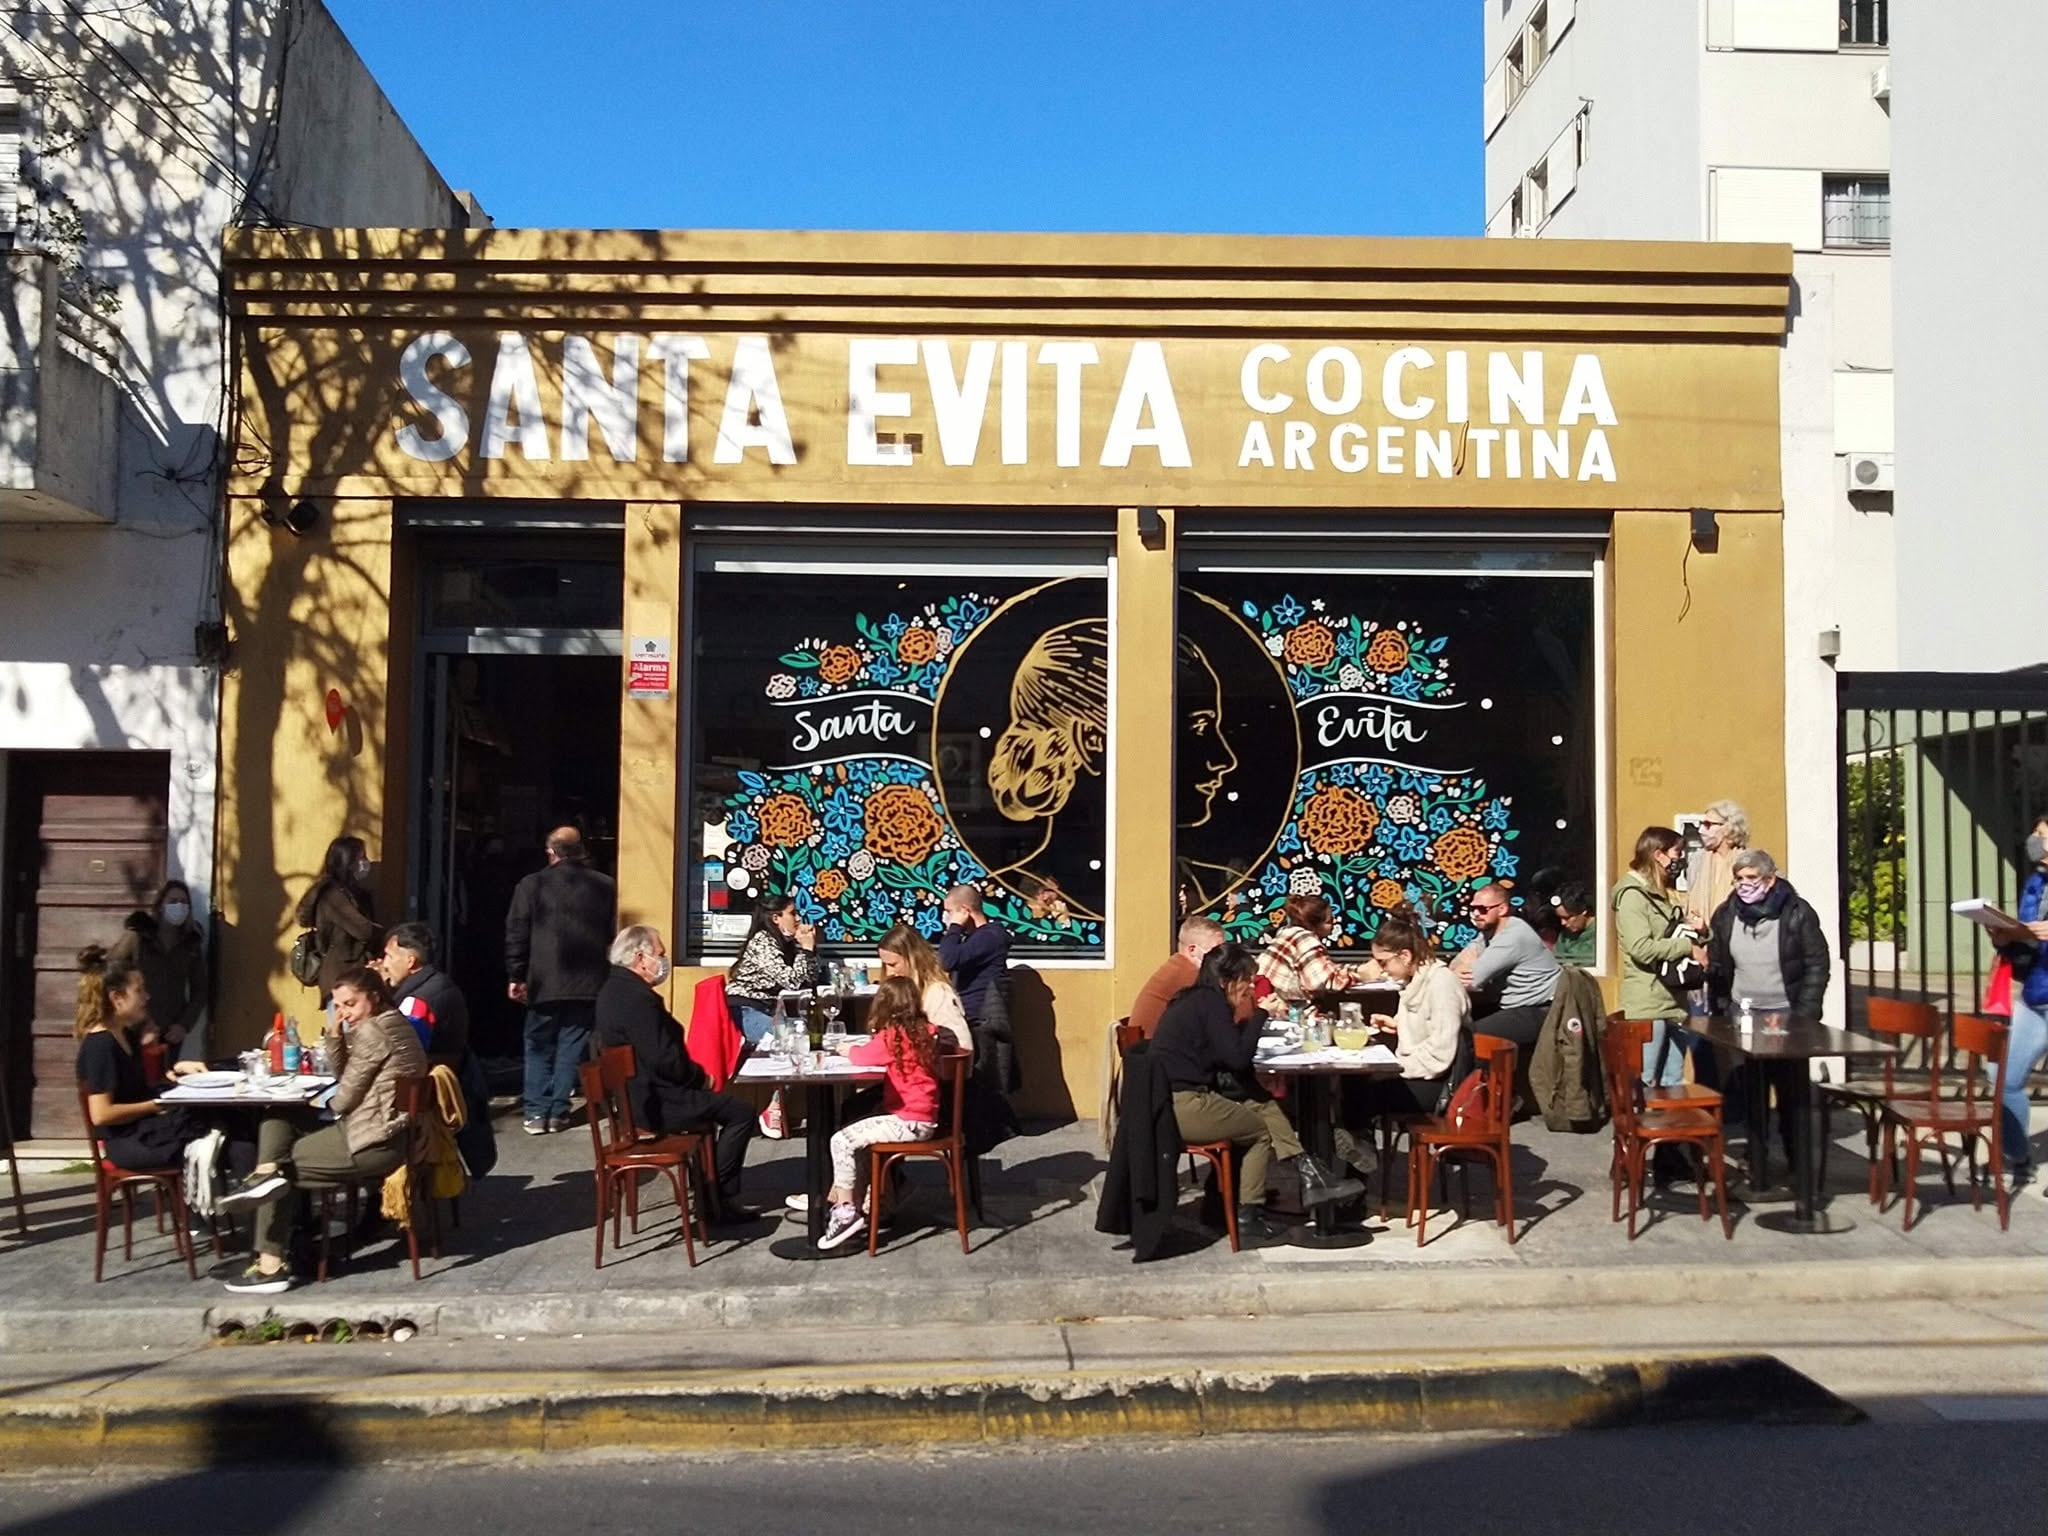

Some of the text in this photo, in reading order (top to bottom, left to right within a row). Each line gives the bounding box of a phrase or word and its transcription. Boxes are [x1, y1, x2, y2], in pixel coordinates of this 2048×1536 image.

[395, 330, 1193, 468] SANTA EVITA
[1240, 343, 1619, 426] COCINA
[1237, 421, 1618, 482] ARGENTINA
[633, 662, 667, 672] Alarma
[792, 699, 916, 751] Santa
[1317, 704, 1428, 751] Evita
